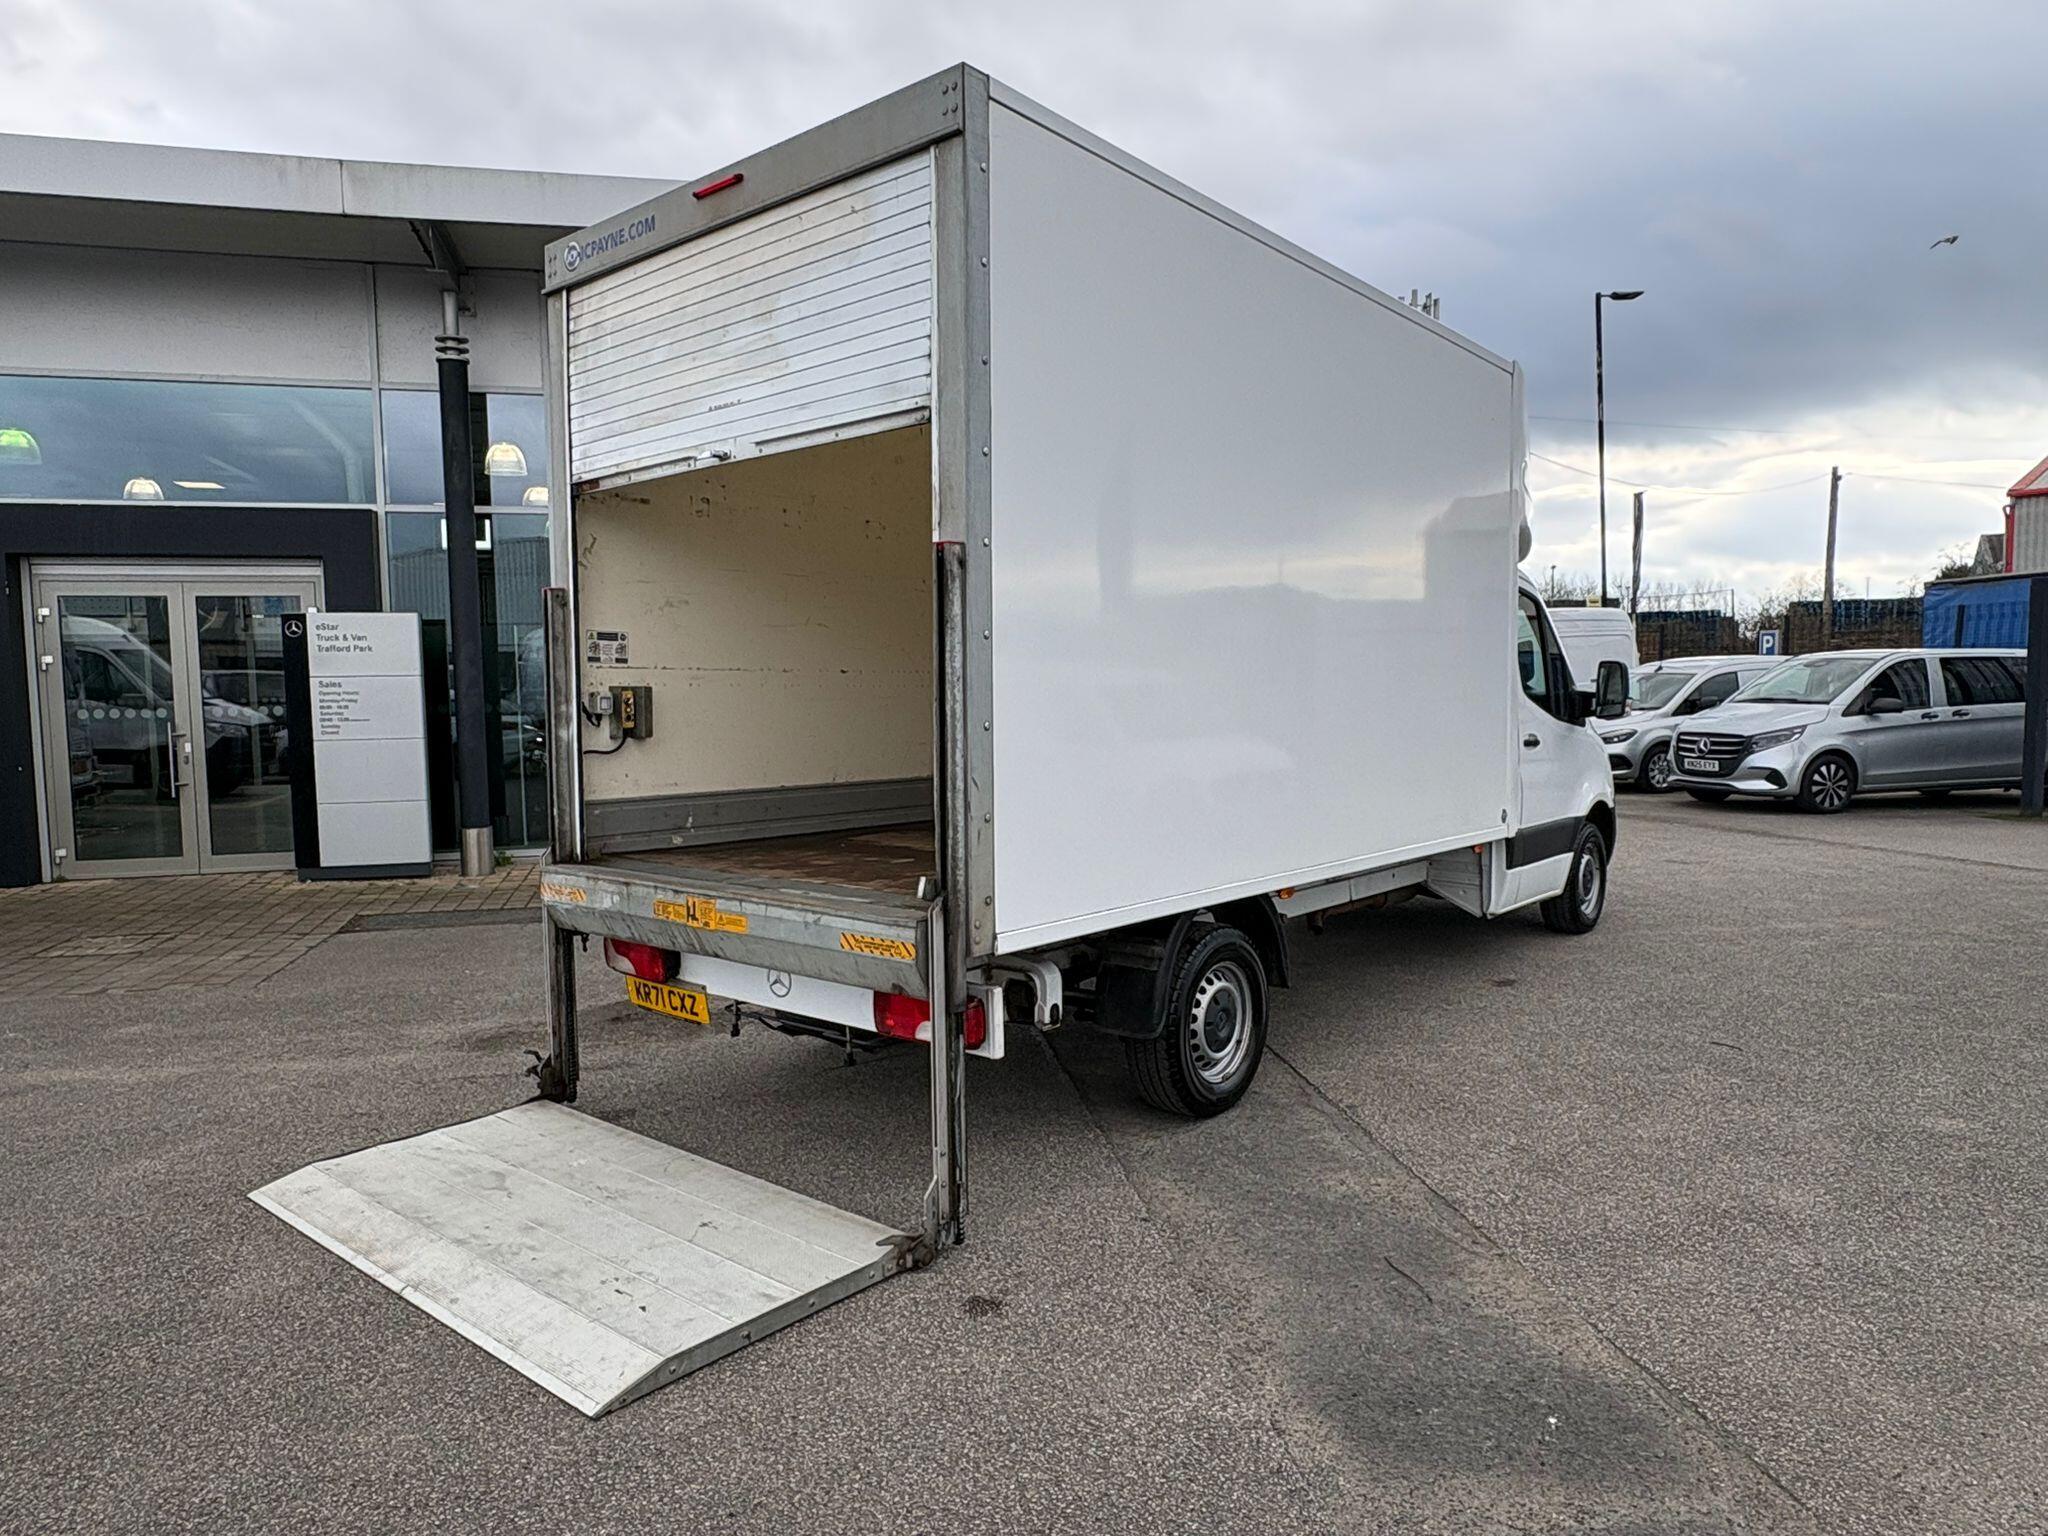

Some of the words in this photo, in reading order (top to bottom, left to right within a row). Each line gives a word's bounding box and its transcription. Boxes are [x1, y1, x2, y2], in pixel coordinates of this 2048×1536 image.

[315, 622, 339, 631] eStar
[316, 633, 340, 641] Truck
[342, 633, 349, 641] &
[350, 633, 368, 641] Van
[316, 644, 351, 653] Trafford
[353, 644, 373, 653] Park
[1762, 635, 1774, 654] P
[318, 680, 342, 688] Sales
[634, 980, 666, 1009] KR71
[667, 989, 699, 1017] CXZ
